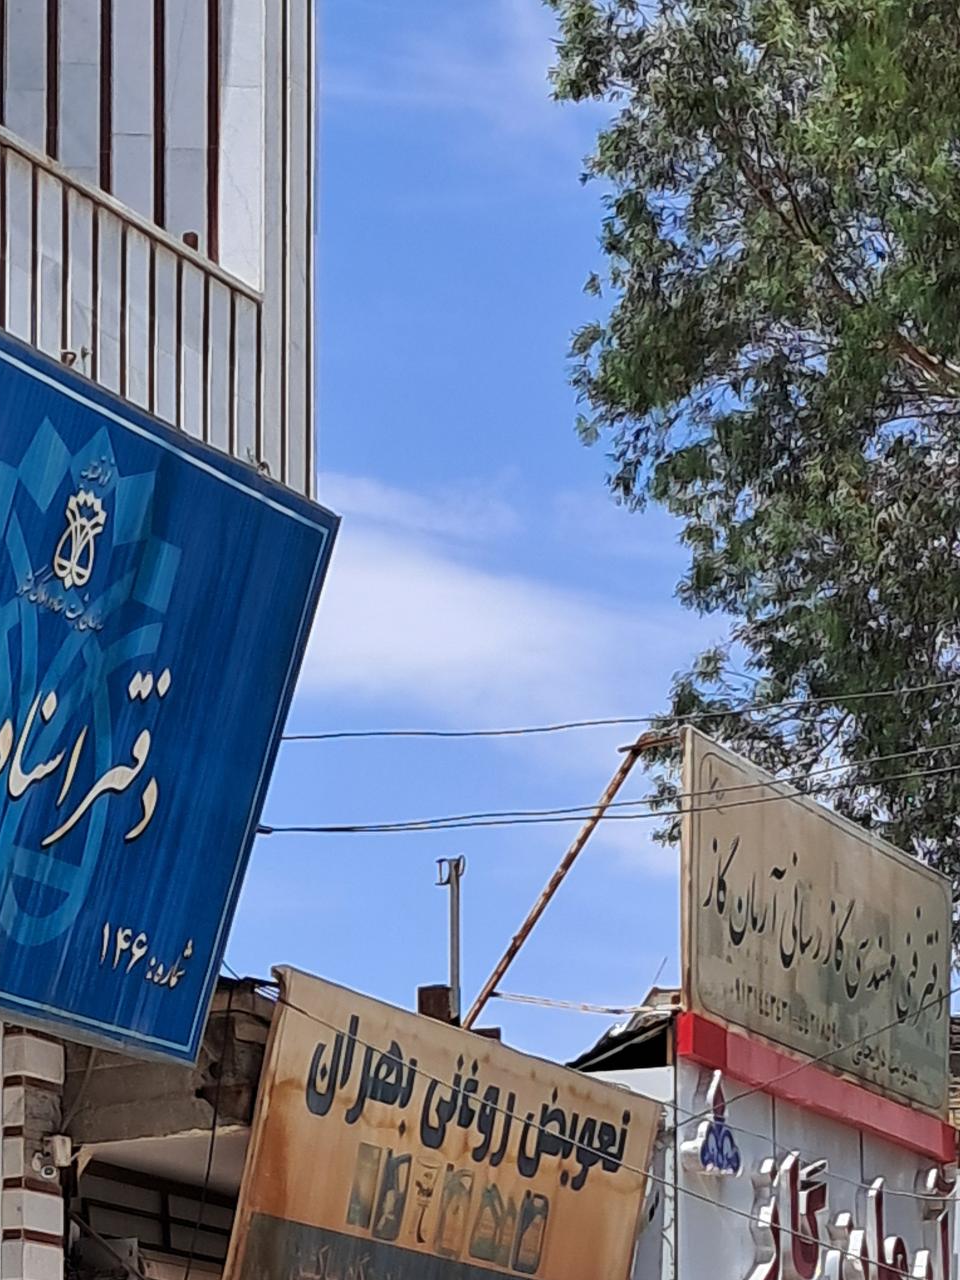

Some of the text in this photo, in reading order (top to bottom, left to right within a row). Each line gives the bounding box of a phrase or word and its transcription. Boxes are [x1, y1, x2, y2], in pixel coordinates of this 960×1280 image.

[42, 667, 172, 847] دفتر
[100, 921, 149, 974] ۱۴۶
[729, 866, 787, 946] آرمان
[912, 929, 942, 1028] دفتر
[305, 1014, 418, 1137] بهران
[516, 1087, 631, 1191] تعویض
